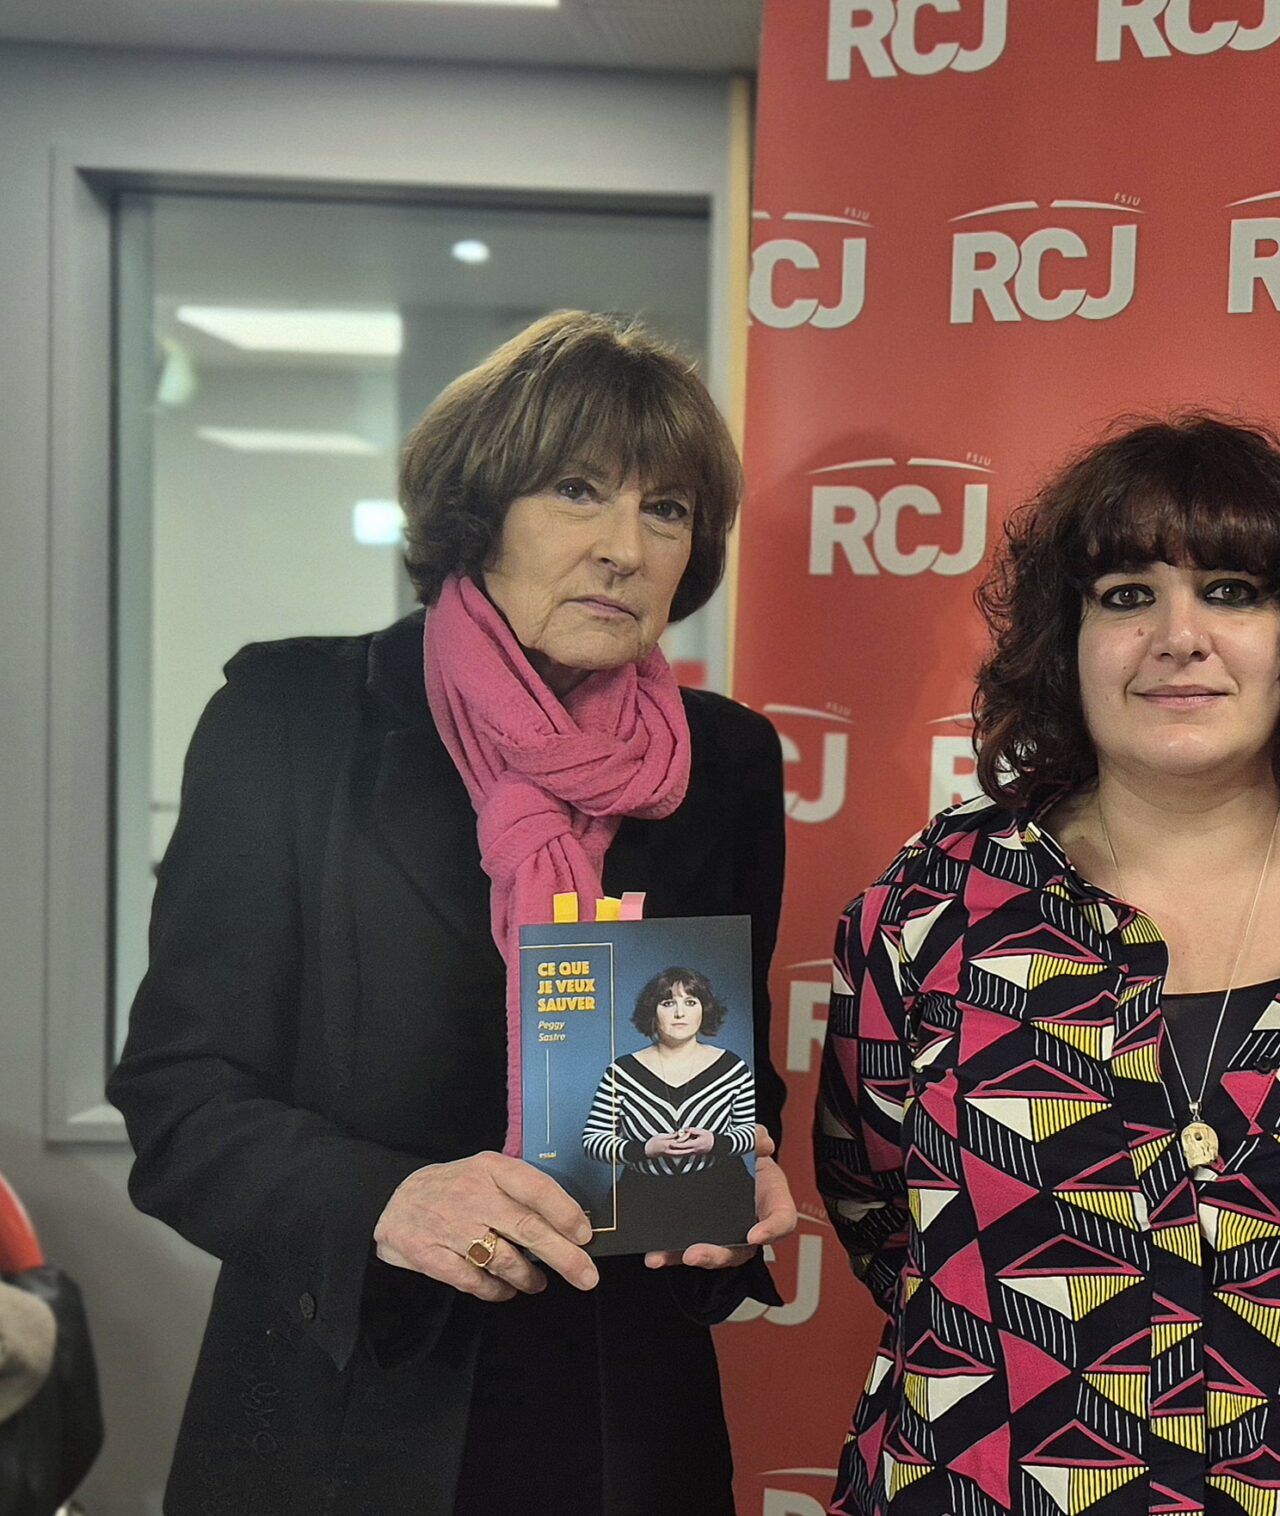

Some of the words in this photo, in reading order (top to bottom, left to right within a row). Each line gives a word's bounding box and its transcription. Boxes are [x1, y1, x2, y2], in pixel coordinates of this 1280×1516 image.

[827, 0, 1009, 81] RCJ
[1113, 191, 1141, 206] FSJU
[748, 237, 867, 329] CJ
[950, 224, 1137, 325] RCJ
[966, 451, 992, 466] FSJU
[809, 484, 988, 577] RCJ
[538, 962, 556, 977] CE
[559, 961, 590, 976] QUE
[537, 980, 553, 995] JE
[555, 978, 596, 994] VEUX
[538, 996, 595, 1013] SAUVER
[538, 1020, 566, 1031] Peggy
[538, 1033, 566, 1042] Sastre
